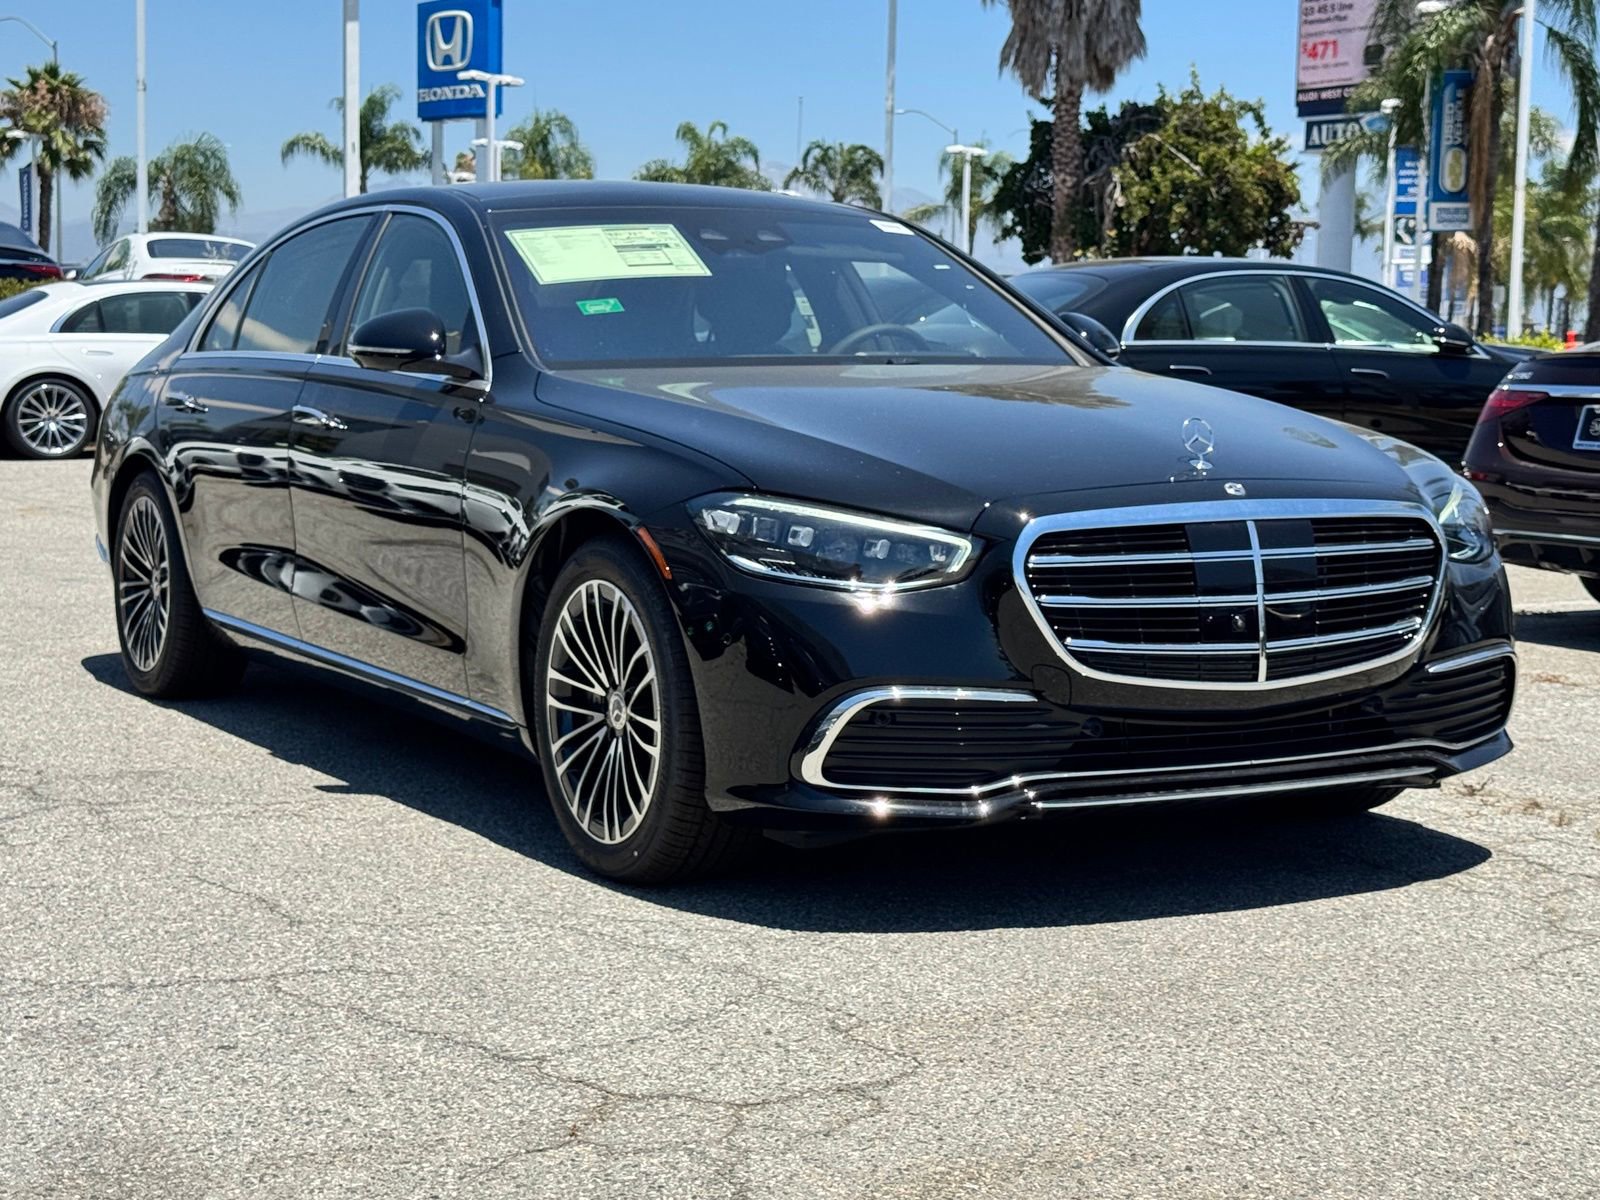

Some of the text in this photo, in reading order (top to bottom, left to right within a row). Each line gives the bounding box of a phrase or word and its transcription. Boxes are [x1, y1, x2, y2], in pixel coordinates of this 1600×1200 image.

[1302, 40, 1339, 60] $471
[418, 84, 486, 102] HONDA
[1320, 88, 1342, 100] WEST
[1308, 121, 1360, 146] AUTO
